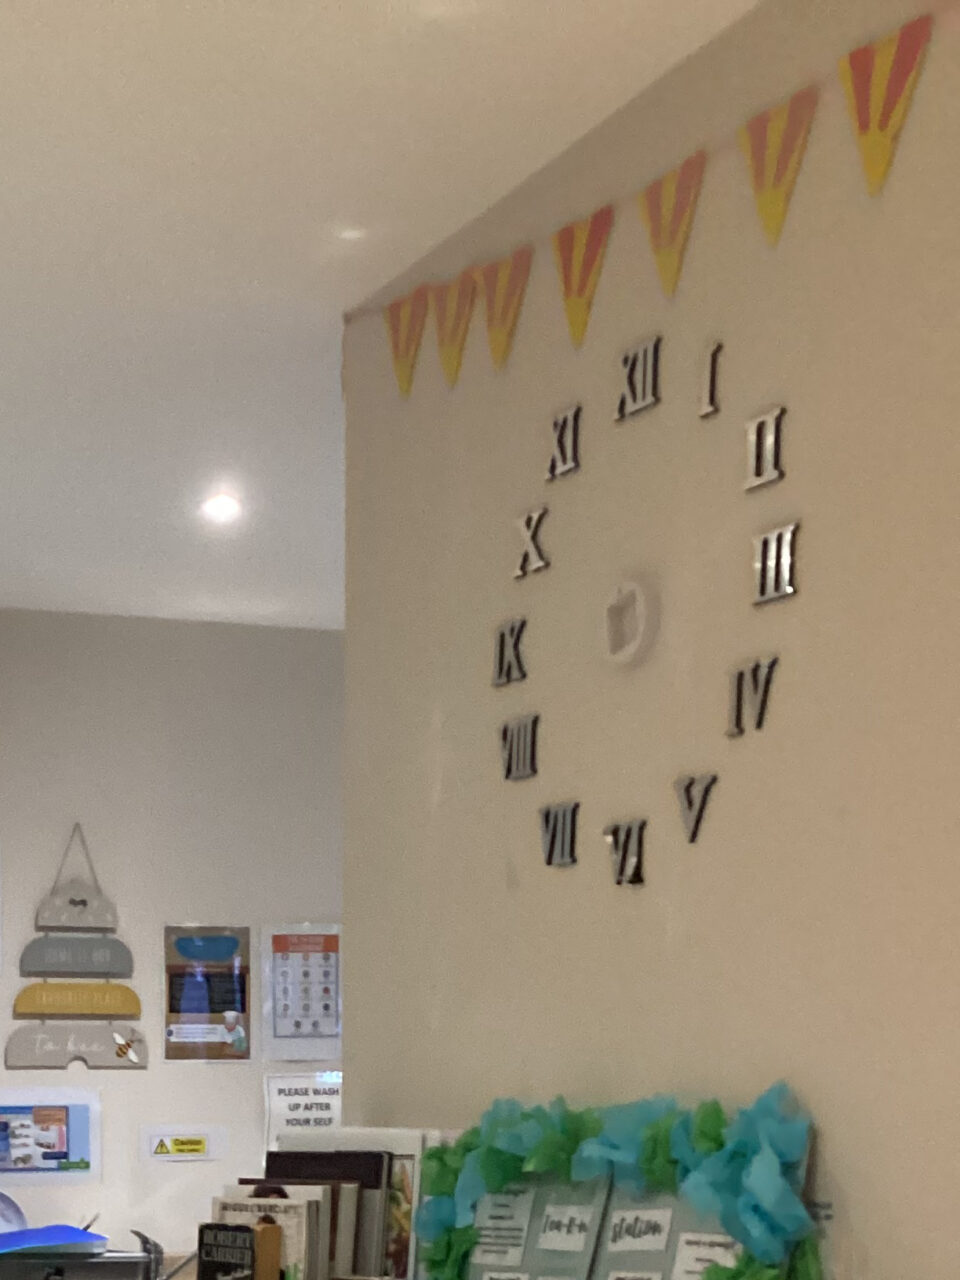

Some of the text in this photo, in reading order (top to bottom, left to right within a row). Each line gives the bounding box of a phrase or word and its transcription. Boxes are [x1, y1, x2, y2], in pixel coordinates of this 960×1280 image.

[614, 335, 663, 421] XII
[699, 341, 723, 418] I
[545, 405, 582, 482] XI
[744, 405, 788, 493] II
[513, 507, 551, 579] X
[753, 520, 801, 605] III
[491, 617, 527, 688] IX
[725, 656, 780, 738] IV
[674, 774, 718, 843] V
[277, 1087, 340, 1096] PLEASE WASH
[286, 1117, 333, 1127] YOUR SELF
[288, 1102, 331, 1112] UP AFTER
